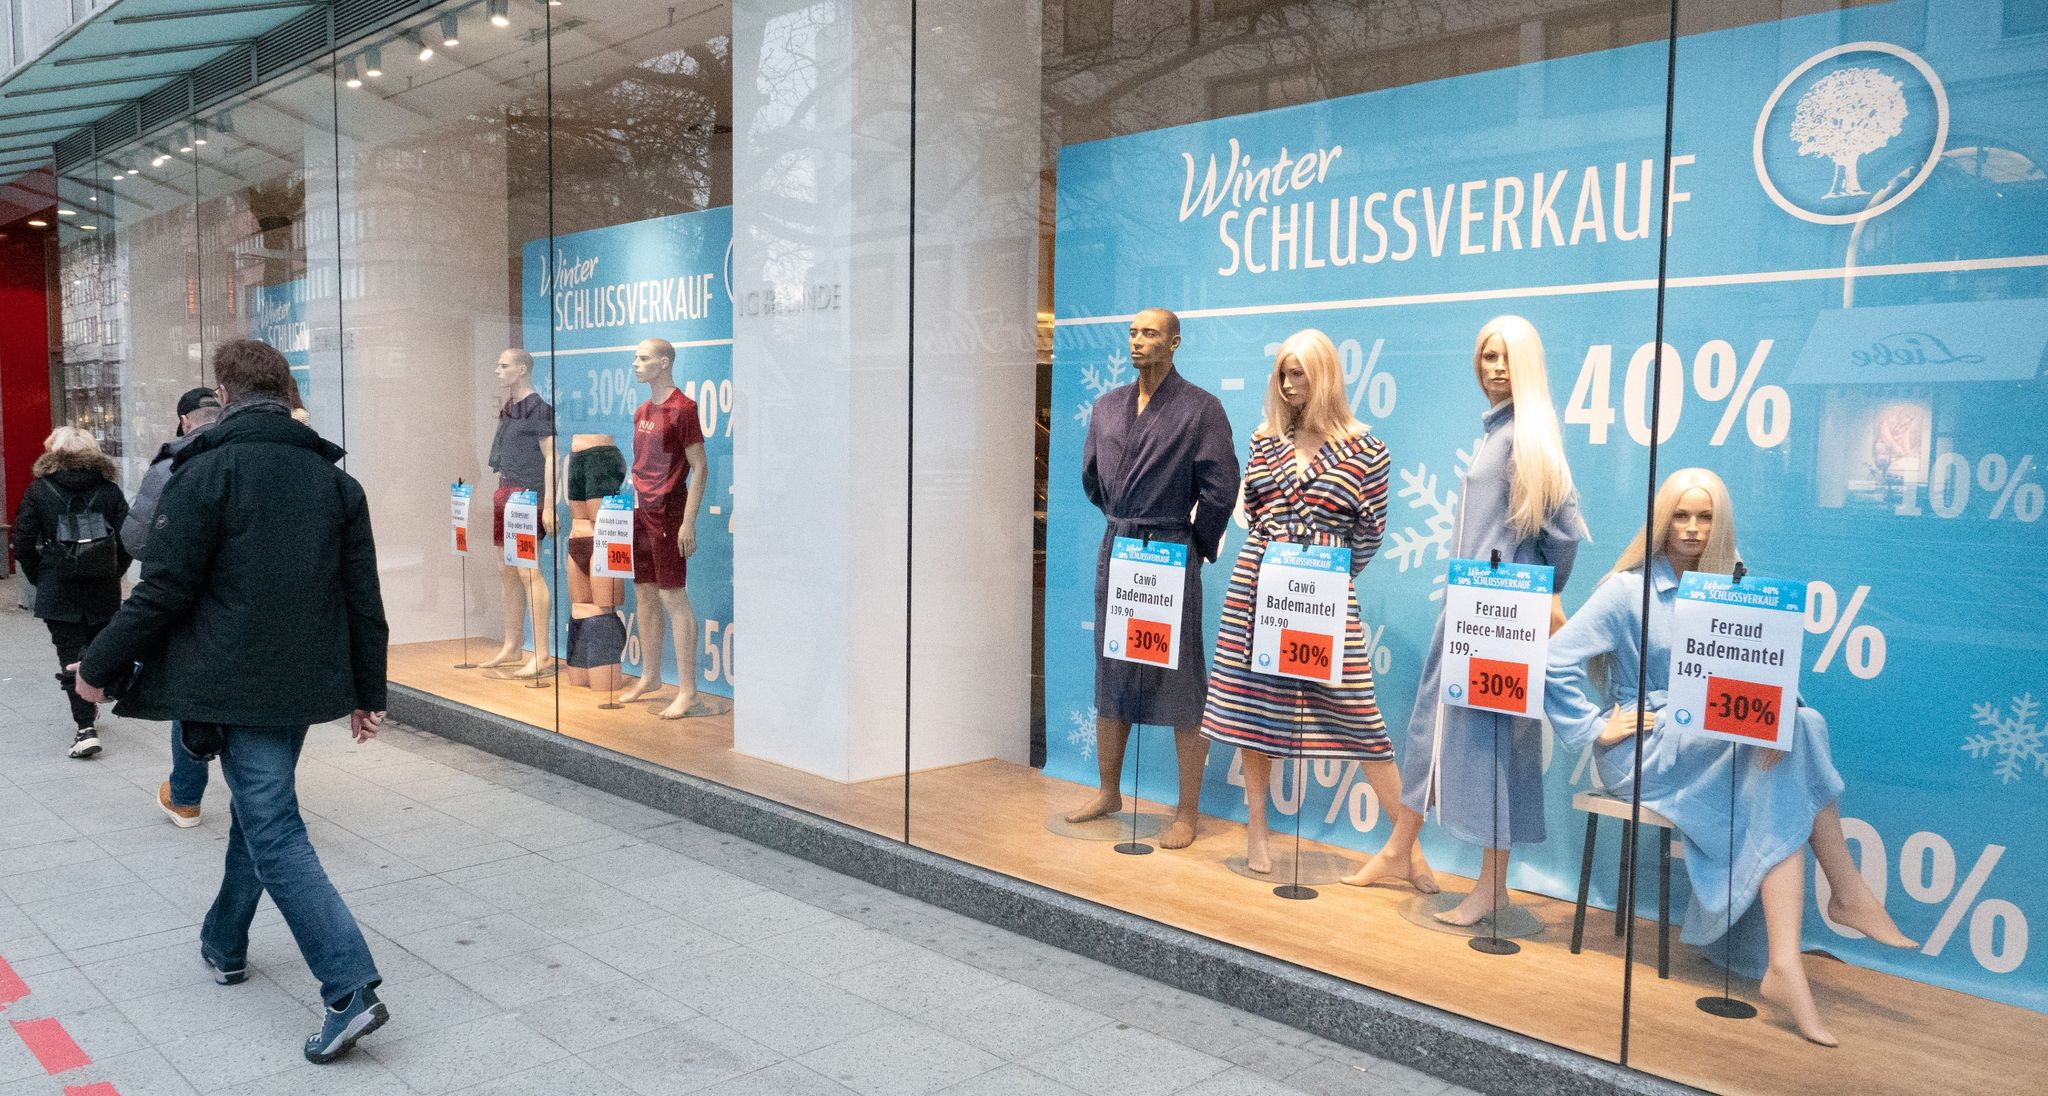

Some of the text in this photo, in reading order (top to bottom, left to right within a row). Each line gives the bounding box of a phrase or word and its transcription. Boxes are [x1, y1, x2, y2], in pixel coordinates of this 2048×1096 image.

[1179, 137, 1343, 223] Winter
[1217, 154, 1696, 277] SCHLUSSVERKAUF
[540, 249, 599, 298] Winter
[555, 273, 714, 332] SCHLUSSVERKAUF
[1565, 338, 1792, 449] 40%
[608, 550, 631, 565] -30%
[1133, 572, 1157, 587] Cawö
[1288, 579, 1316, 595] Cawö
[1473, 576, 1532, 589] SCHLUSSVERKAUF
[1116, 587, 1174, 607] Bademantel
[1266, 595, 1336, 617] Bademantel
[1708, 590, 1780, 607] SCHLUSSVERKAUF
[1110, 605, 1134, 618] 139.90
[1475, 601, 1518, 619] Feraud
[1260, 615, 1289, 629] 149.90
[1456, 620, 1536, 642] Fleece-Mantel
[1711, 618, 1763, 639] Feraud
[1128, 629, 1168, 653] -30%
[1449, 641, 1479, 656] 199.-
[1282, 641, 1329, 668] -30%
[1686, 637, 1785, 667] Bademantel
[1677, 660, 1713, 680] 149.-
[1471, 672, 1525, 700] -30%
[1710, 692, 1776, 726] -30%
